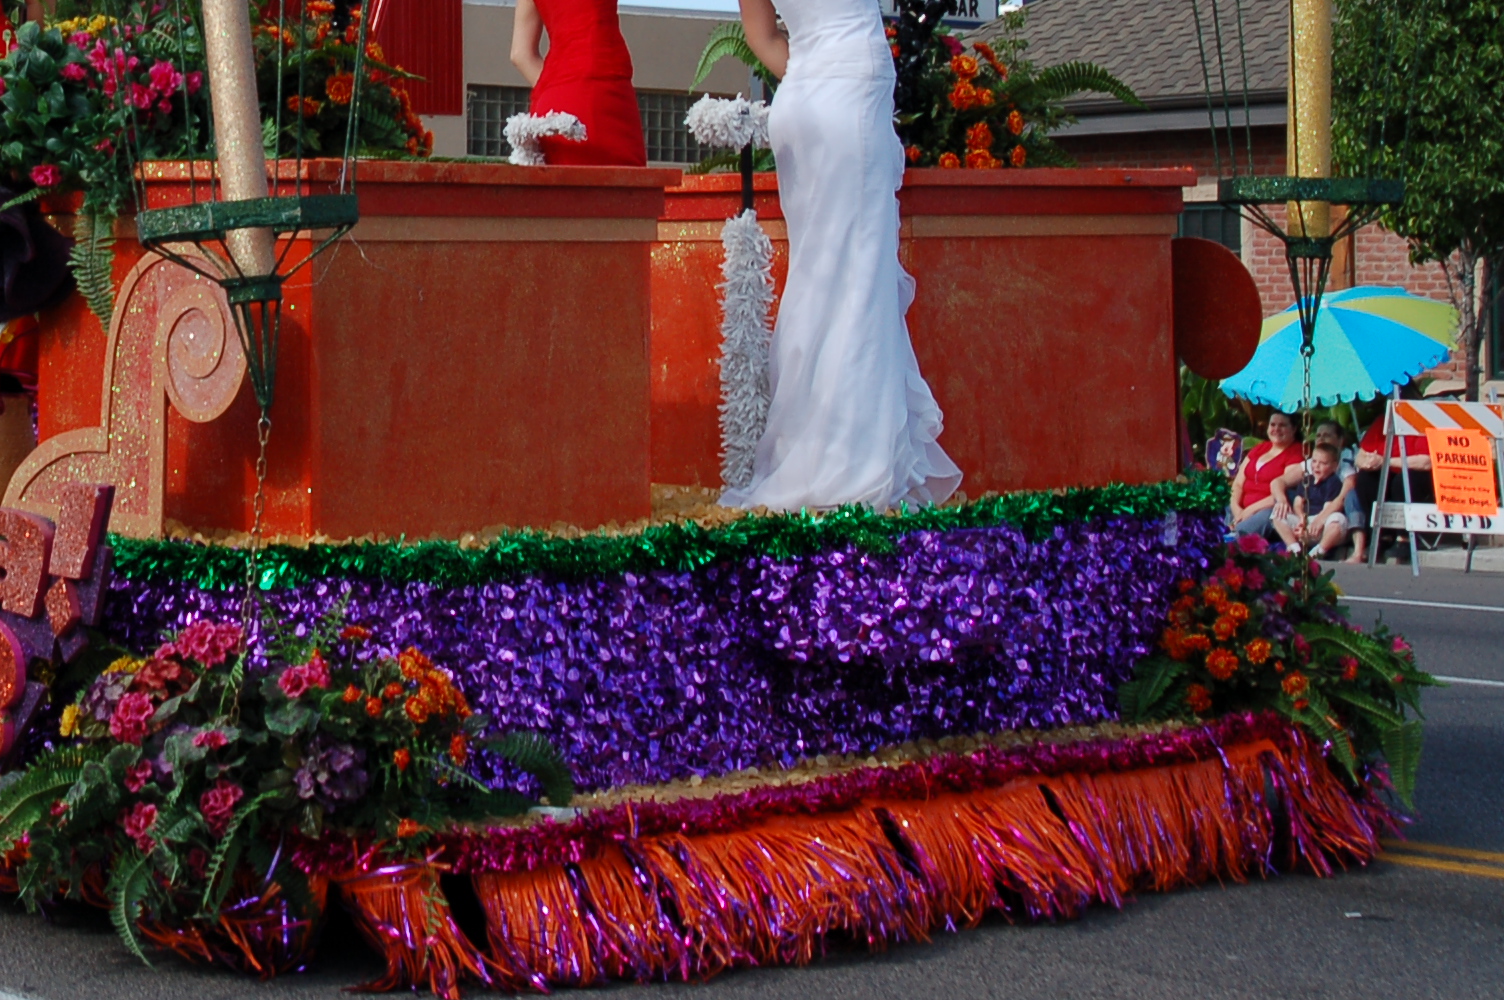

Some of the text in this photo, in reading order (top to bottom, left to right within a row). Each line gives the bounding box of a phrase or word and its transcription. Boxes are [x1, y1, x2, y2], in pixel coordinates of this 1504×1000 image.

[1447, 436, 1470, 447] NO
[1436, 453, 1487, 466] PARKING
[1441, 495, 1492, 507] Police Dept.
